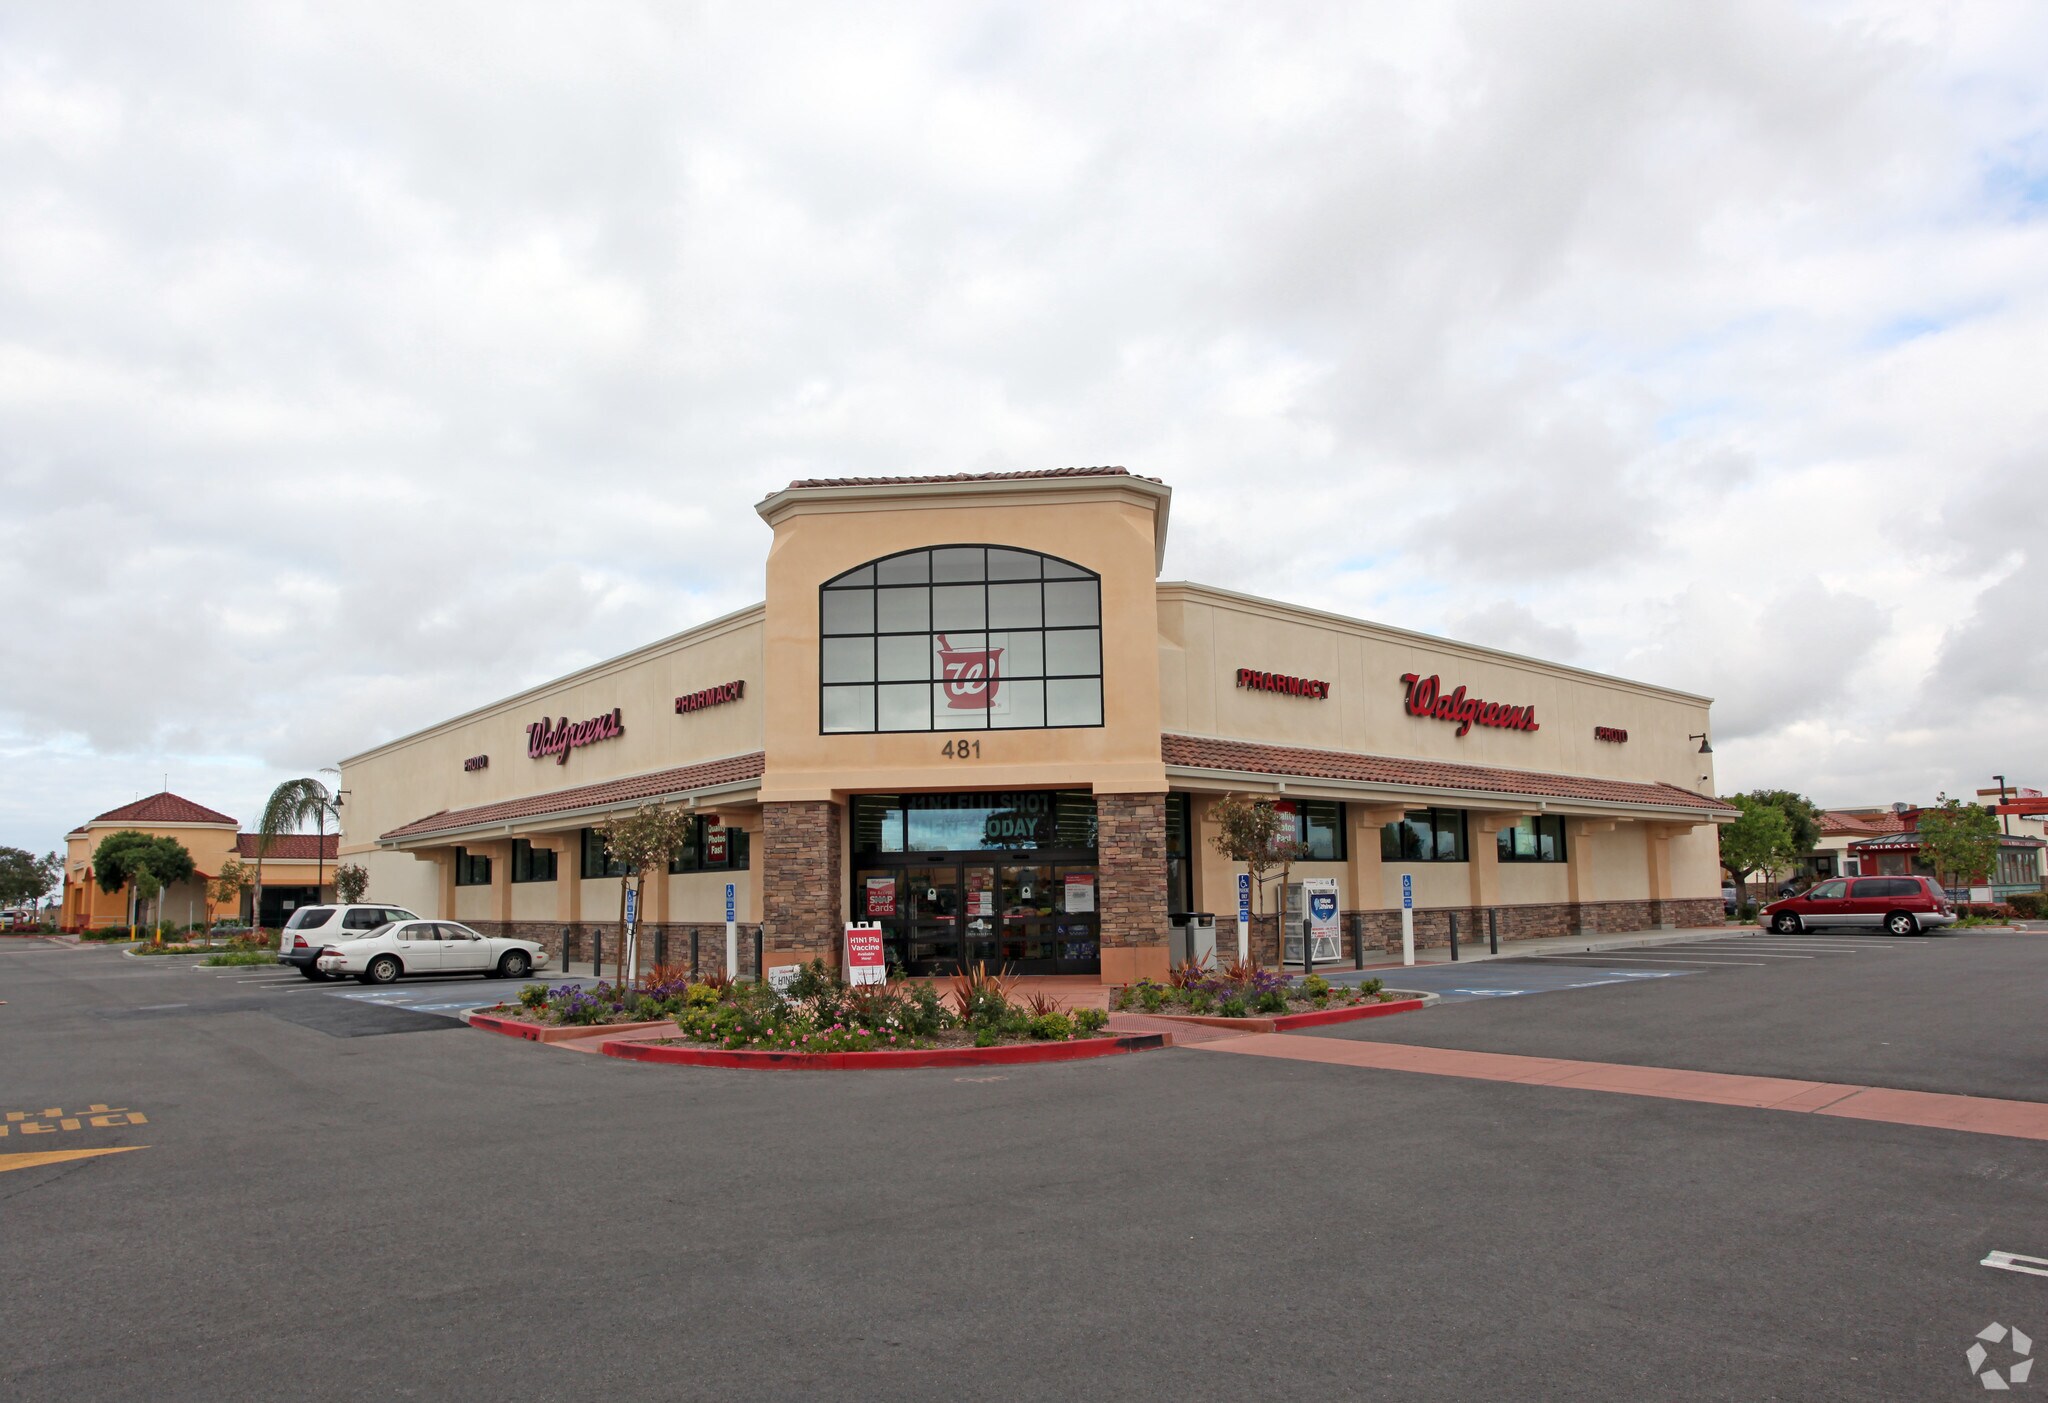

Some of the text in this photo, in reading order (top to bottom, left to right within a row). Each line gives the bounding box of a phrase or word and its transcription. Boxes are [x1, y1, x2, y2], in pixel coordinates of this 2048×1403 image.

[1237, 668, 1330, 699] PHARMACY
[675, 680, 745, 714] PHARMACY
[1401, 672, 1539, 737] Walgreens
[526, 708, 624, 765] Walgreens
[1595, 726, 1628, 743] PHOTO
[941, 739, 980, 759] 481
[464, 755, 488, 771] PHOTO
[986, 818, 1039, 838] ODAY
[708, 834, 726, 844] Photos
[1869, 842, 1918, 851] MIRACL
[711, 845, 723, 855] Fast
[869, 903, 894, 913] Cards
[850, 936, 868, 944] H1N1
